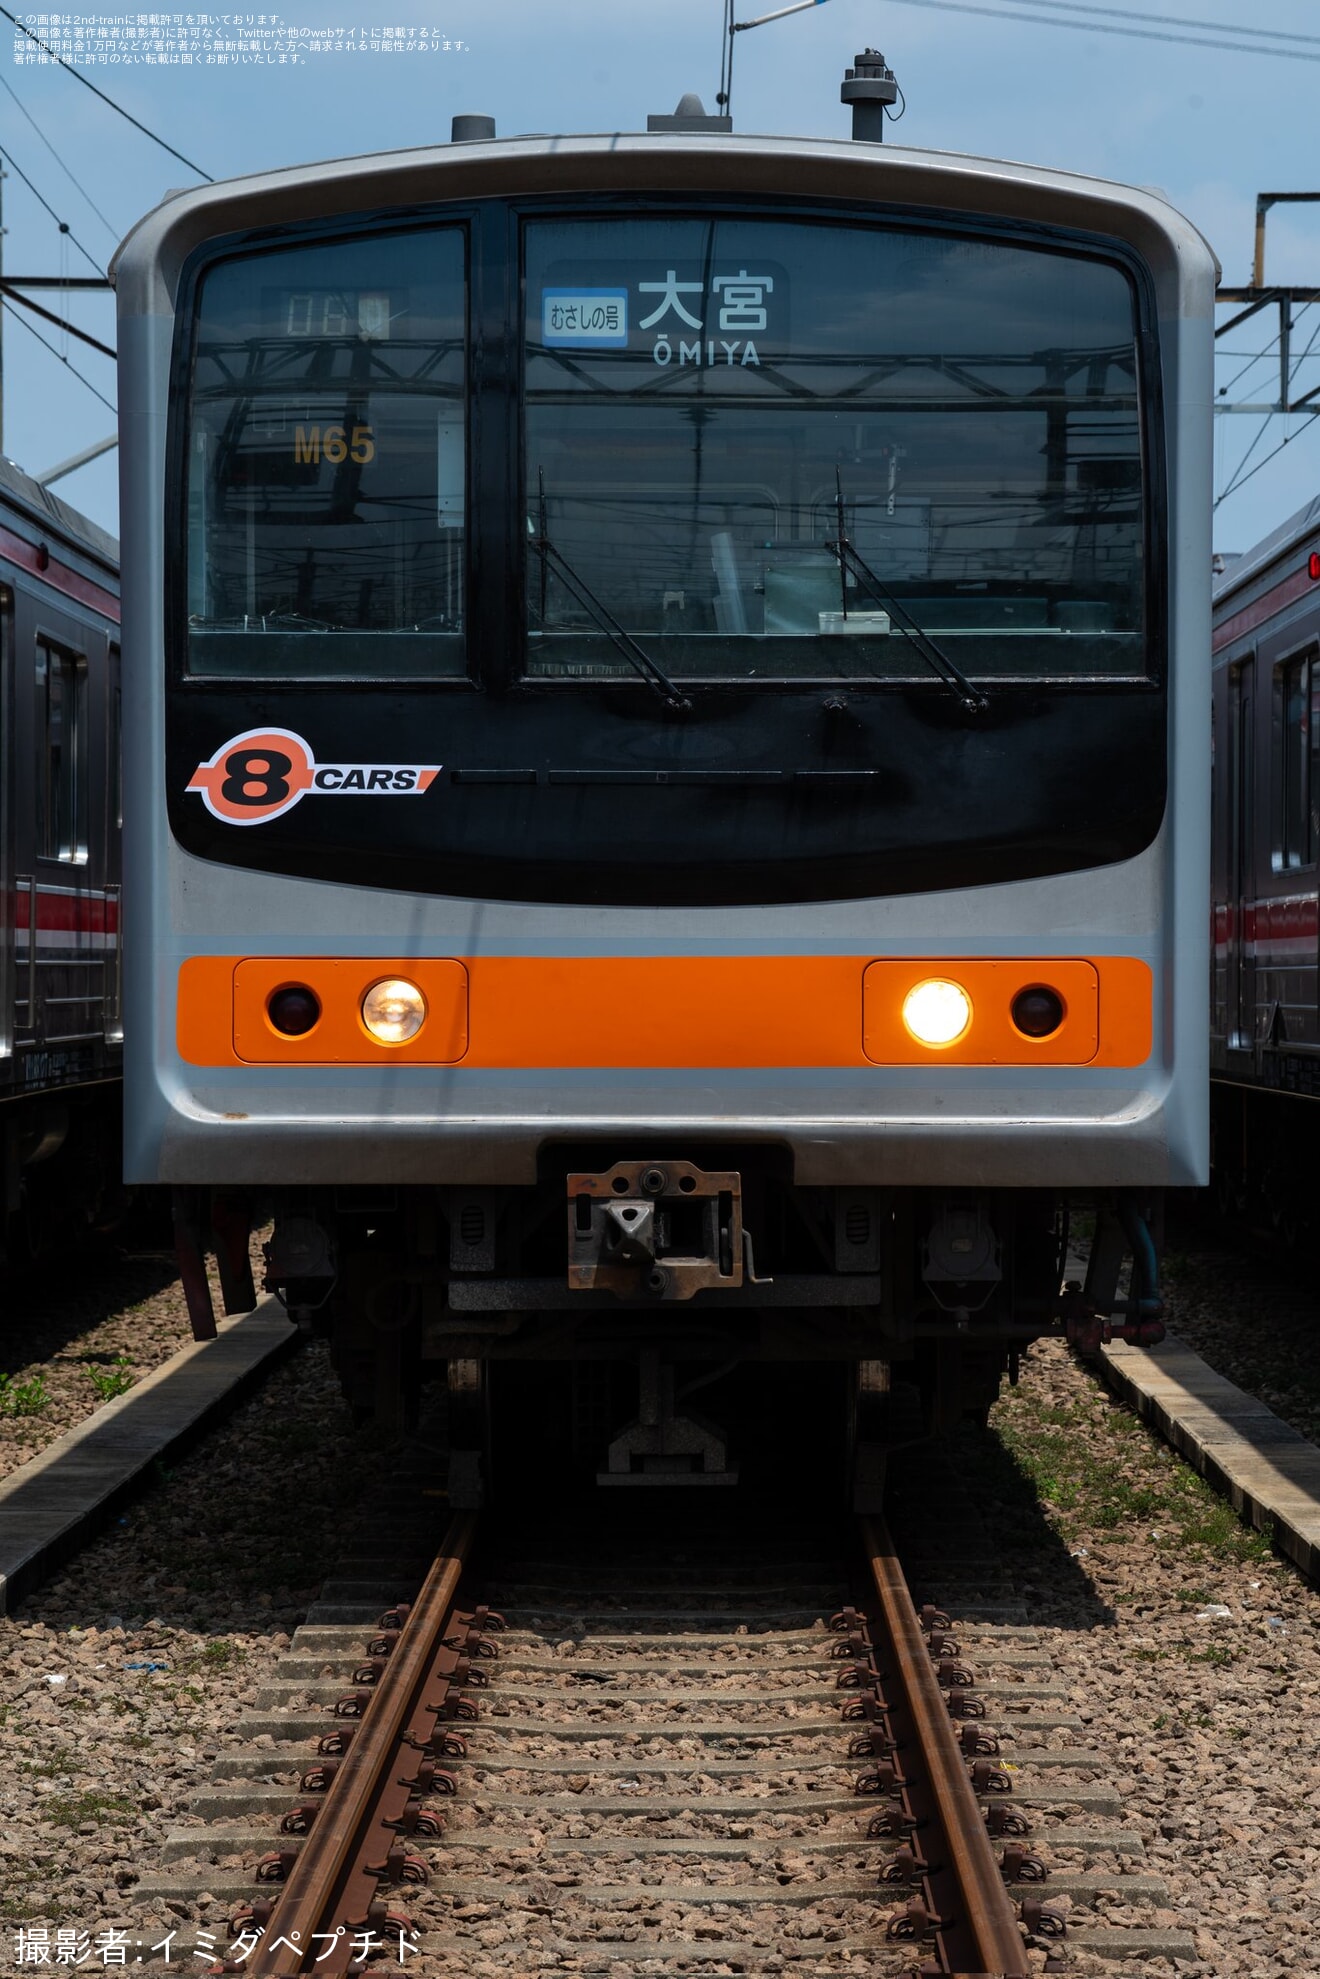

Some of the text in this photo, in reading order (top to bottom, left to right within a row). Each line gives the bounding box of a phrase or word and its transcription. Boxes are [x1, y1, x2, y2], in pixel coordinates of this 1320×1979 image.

[551, 304, 619, 331] むさしの号
[638, 270, 774, 330] 大宮
[653, 334, 761, 366] ŌMIYA
[294, 426, 375, 464] M65
[221, 749, 417, 806] 8 CARS
